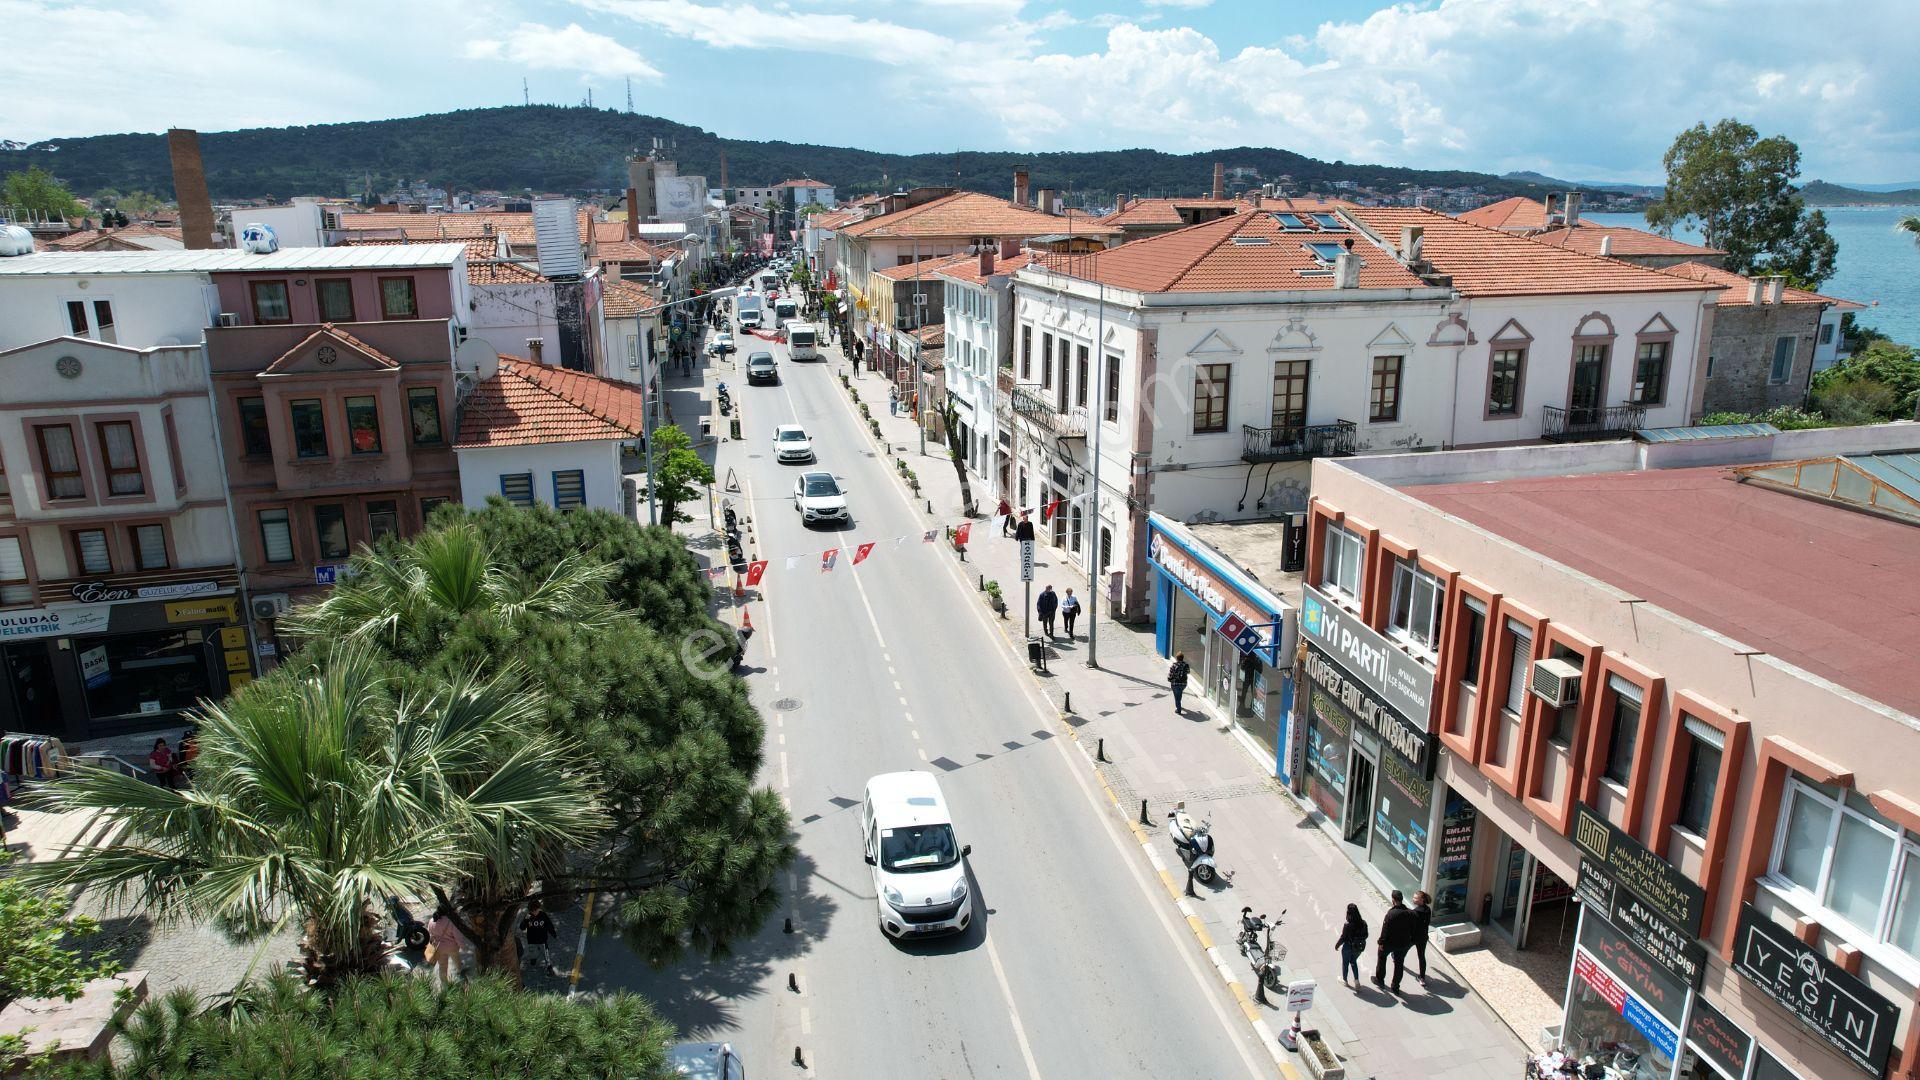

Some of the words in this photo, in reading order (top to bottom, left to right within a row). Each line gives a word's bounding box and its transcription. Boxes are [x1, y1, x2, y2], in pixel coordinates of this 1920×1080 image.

[72, 582, 132, 602] Esen
[1, 612, 60, 627] ULUDAĞ
[2, 622, 61, 636] ELEKTRİK
[1320, 606, 1340, 647] İYİ
[1341, 628, 1386, 682] PARTİ
[1388, 672, 1398, 687] İLÇE
[1397, 668, 1417, 688] AYVALIK
[1305, 652, 1343, 698] KÖRFEZ
[1342, 680, 1380, 730] EMLAK
[1379, 706, 1425, 764] İNŞAAT
[1312, 692, 1349, 736] KÖRFEZ
[1384, 756, 1431, 803] EMLAK
[1444, 836, 1471, 845] İNŞAAT
[1446, 826, 1471, 835] EMLAK
[1446, 845, 1466, 853] PLAN
[1443, 855, 1467, 863] PROJE
[1614, 846, 1654, 879] MİMARLIK
[1656, 872, 1690, 905] İNŞAAT
[1609, 853, 1636, 879] EMLAK
[1638, 875, 1671, 906] YATIRIM
[1631, 902, 1687, 951] AVUKAT
[1617, 956, 1664, 1002] GİYİM
[1757, 944, 1864, 1040] YEĞİN
[1774, 983, 1833, 1029] MİMARLIK
[1707, 1033, 1744, 1069] GİYİM
